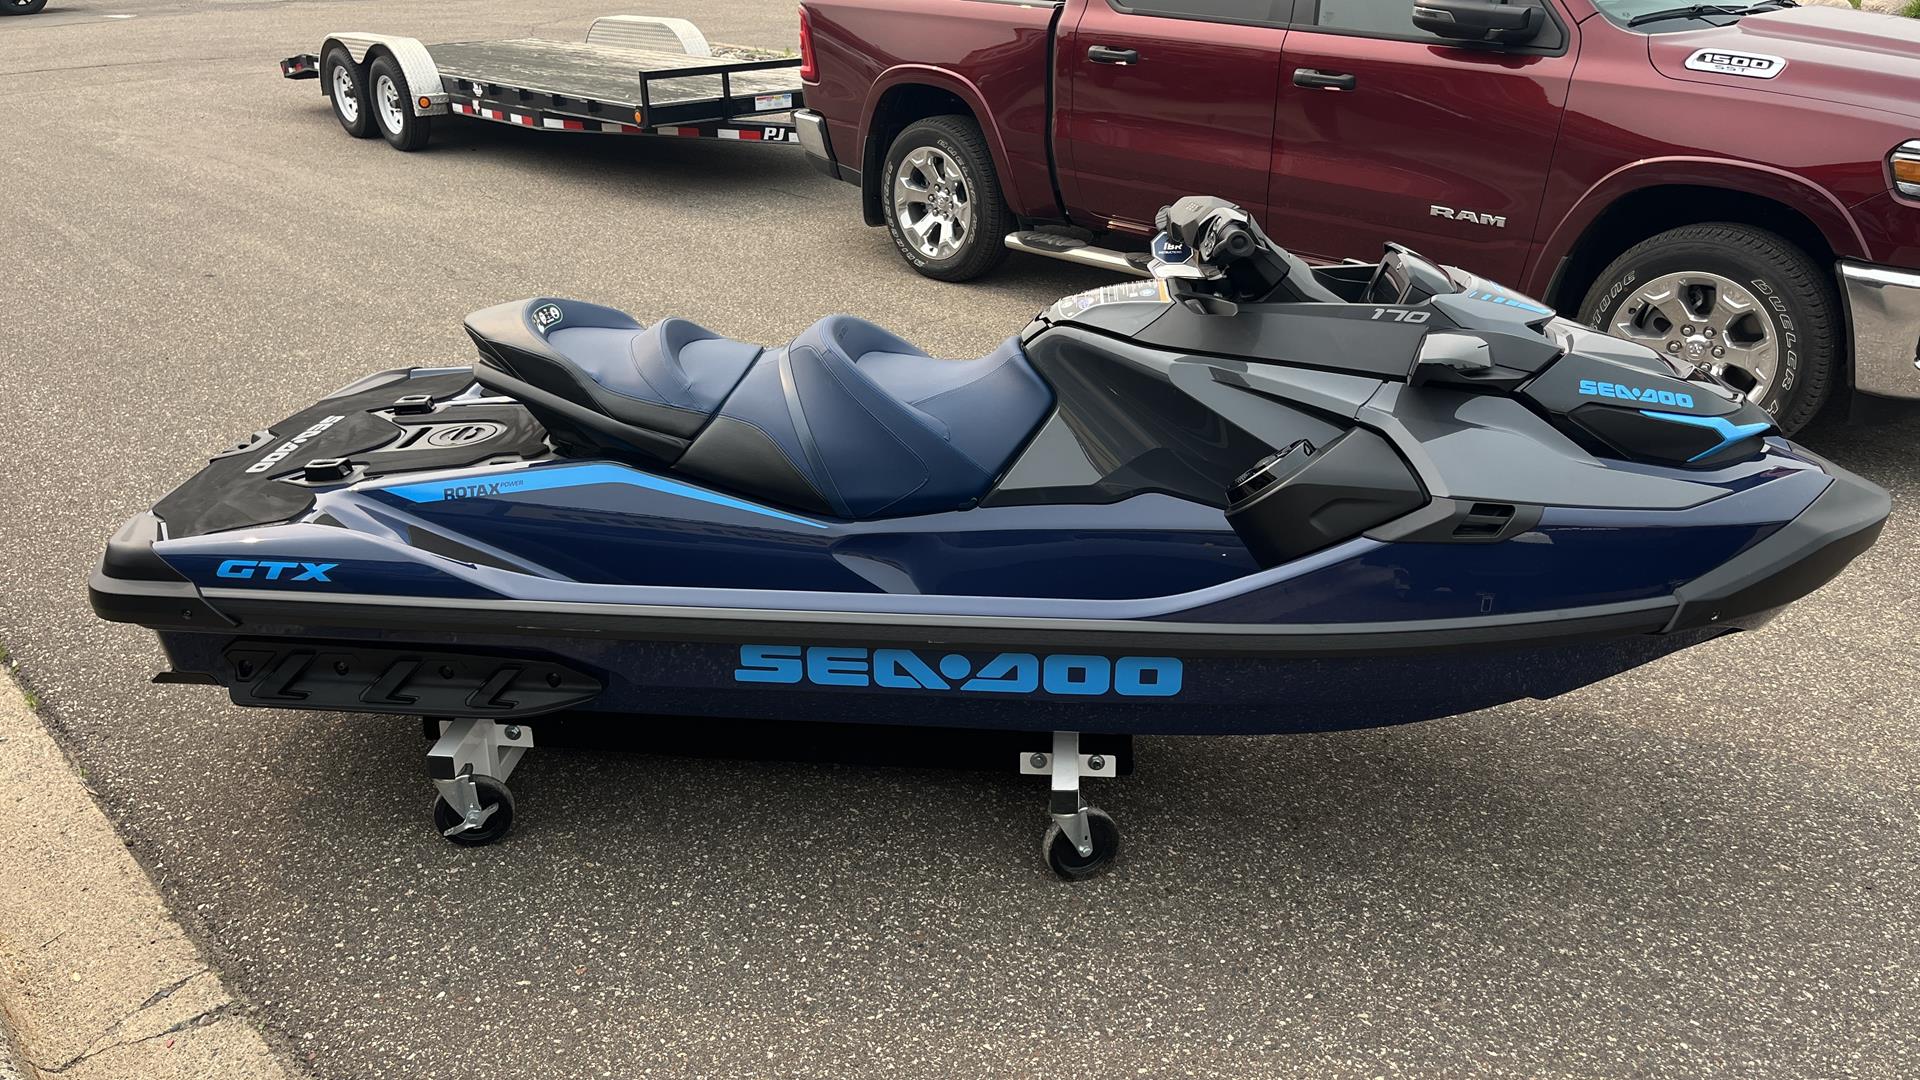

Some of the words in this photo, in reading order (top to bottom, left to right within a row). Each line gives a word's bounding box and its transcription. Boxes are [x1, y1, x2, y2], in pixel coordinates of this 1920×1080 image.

[1703, 53, 1770, 70] 1500
[763, 127, 786, 141] PJ
[1430, 204, 1507, 228] RAM
[1371, 308, 1431, 324] 170
[1751, 279, 1797, 391] DUELER
[443, 482, 501, 502] ROTAX
[216, 559, 340, 582] GTX
